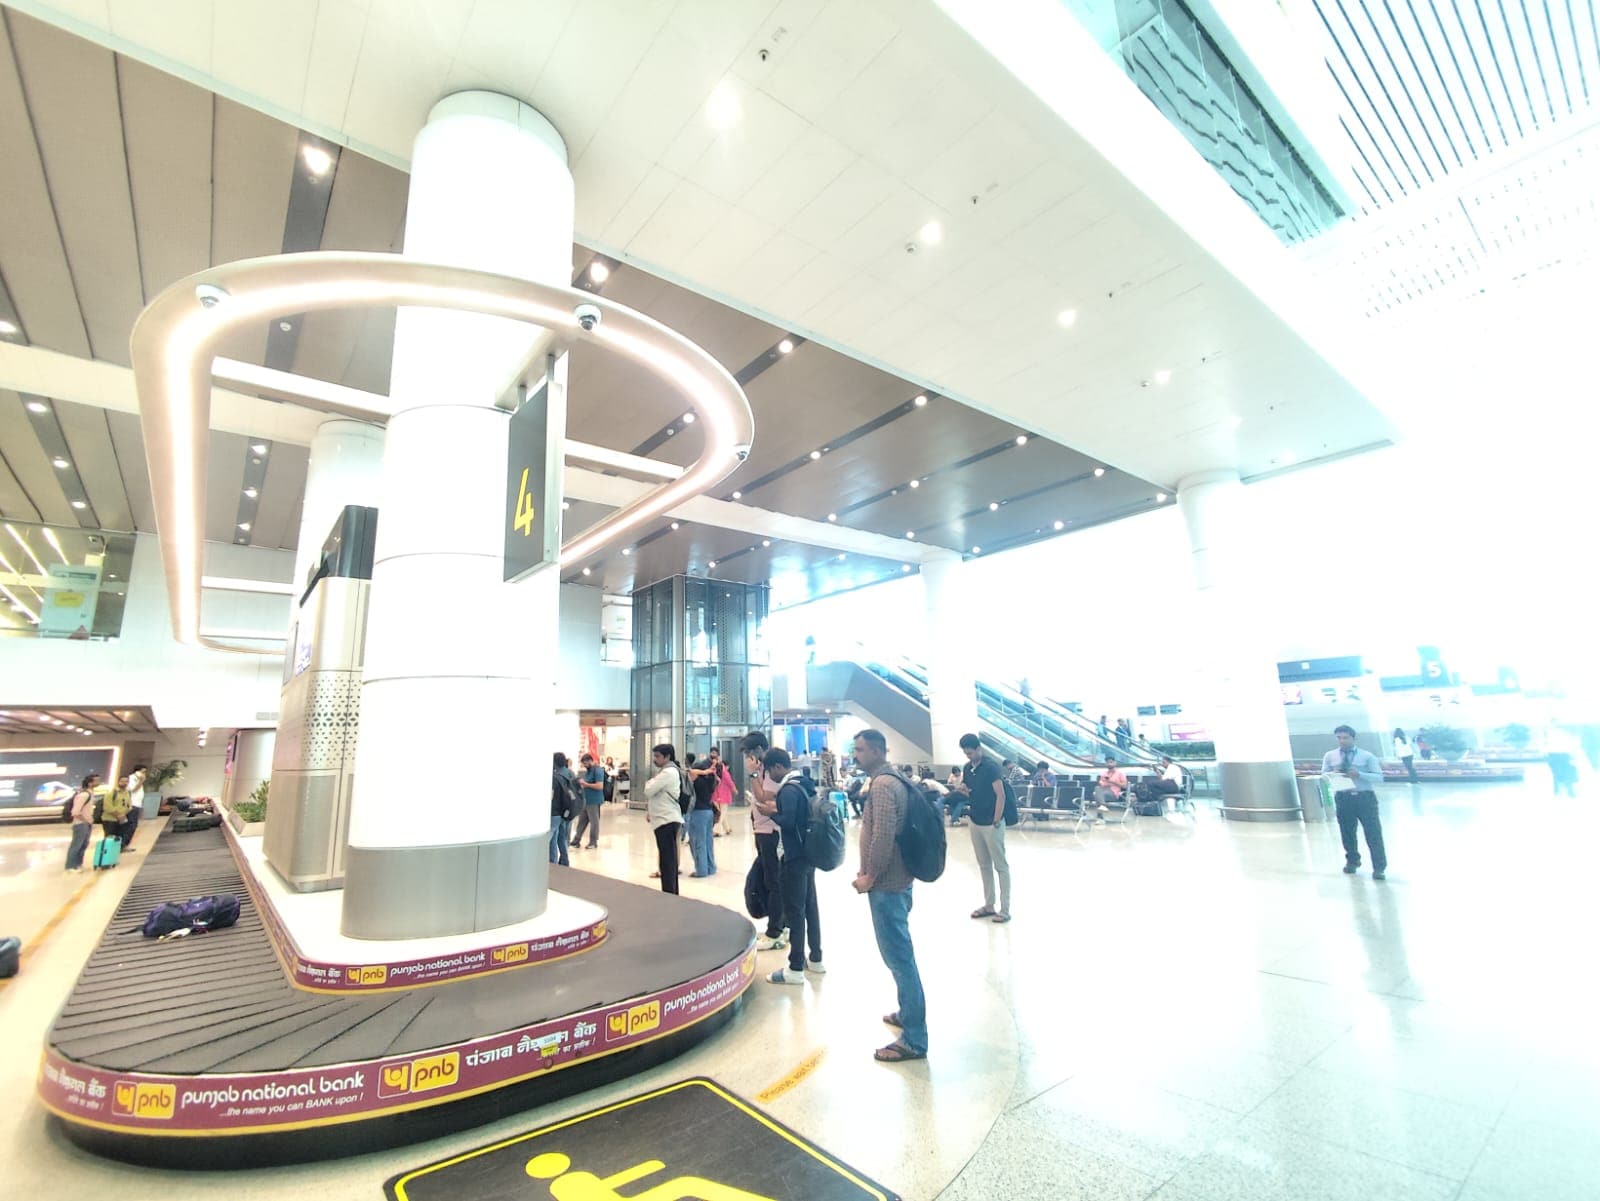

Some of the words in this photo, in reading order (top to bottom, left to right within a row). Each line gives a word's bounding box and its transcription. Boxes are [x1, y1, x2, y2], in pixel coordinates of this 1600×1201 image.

[514, 468, 534, 537] 4
[1426, 661, 1442, 679] 5
[390, 963, 424, 977] punjab
[425, 957, 463, 972] national
[463, 952, 486, 964] bank
[507, 946, 527, 960] pnb
[362, 968, 385, 983] pnb
[664, 990, 697, 1016] punjab
[697, 975, 727, 999] national
[725, 967, 739, 986] bank
[573, 1021, 597, 1039] बैंक
[630, 1007, 657, 1031] pnb
[414, 1059, 455, 1088] pnb
[137, 1089, 172, 1113] pnb
[181, 1085, 240, 1109] punjab
[241, 1078, 316, 1102] national
[319, 1071, 365, 1093] bank
[242, 1106, 266, 1115] name
[268, 1104, 285, 1114] you
[287, 1103, 304, 1112] can
[305, 1098, 333, 1109] BANK
[335, 1095, 357, 1106] upon
